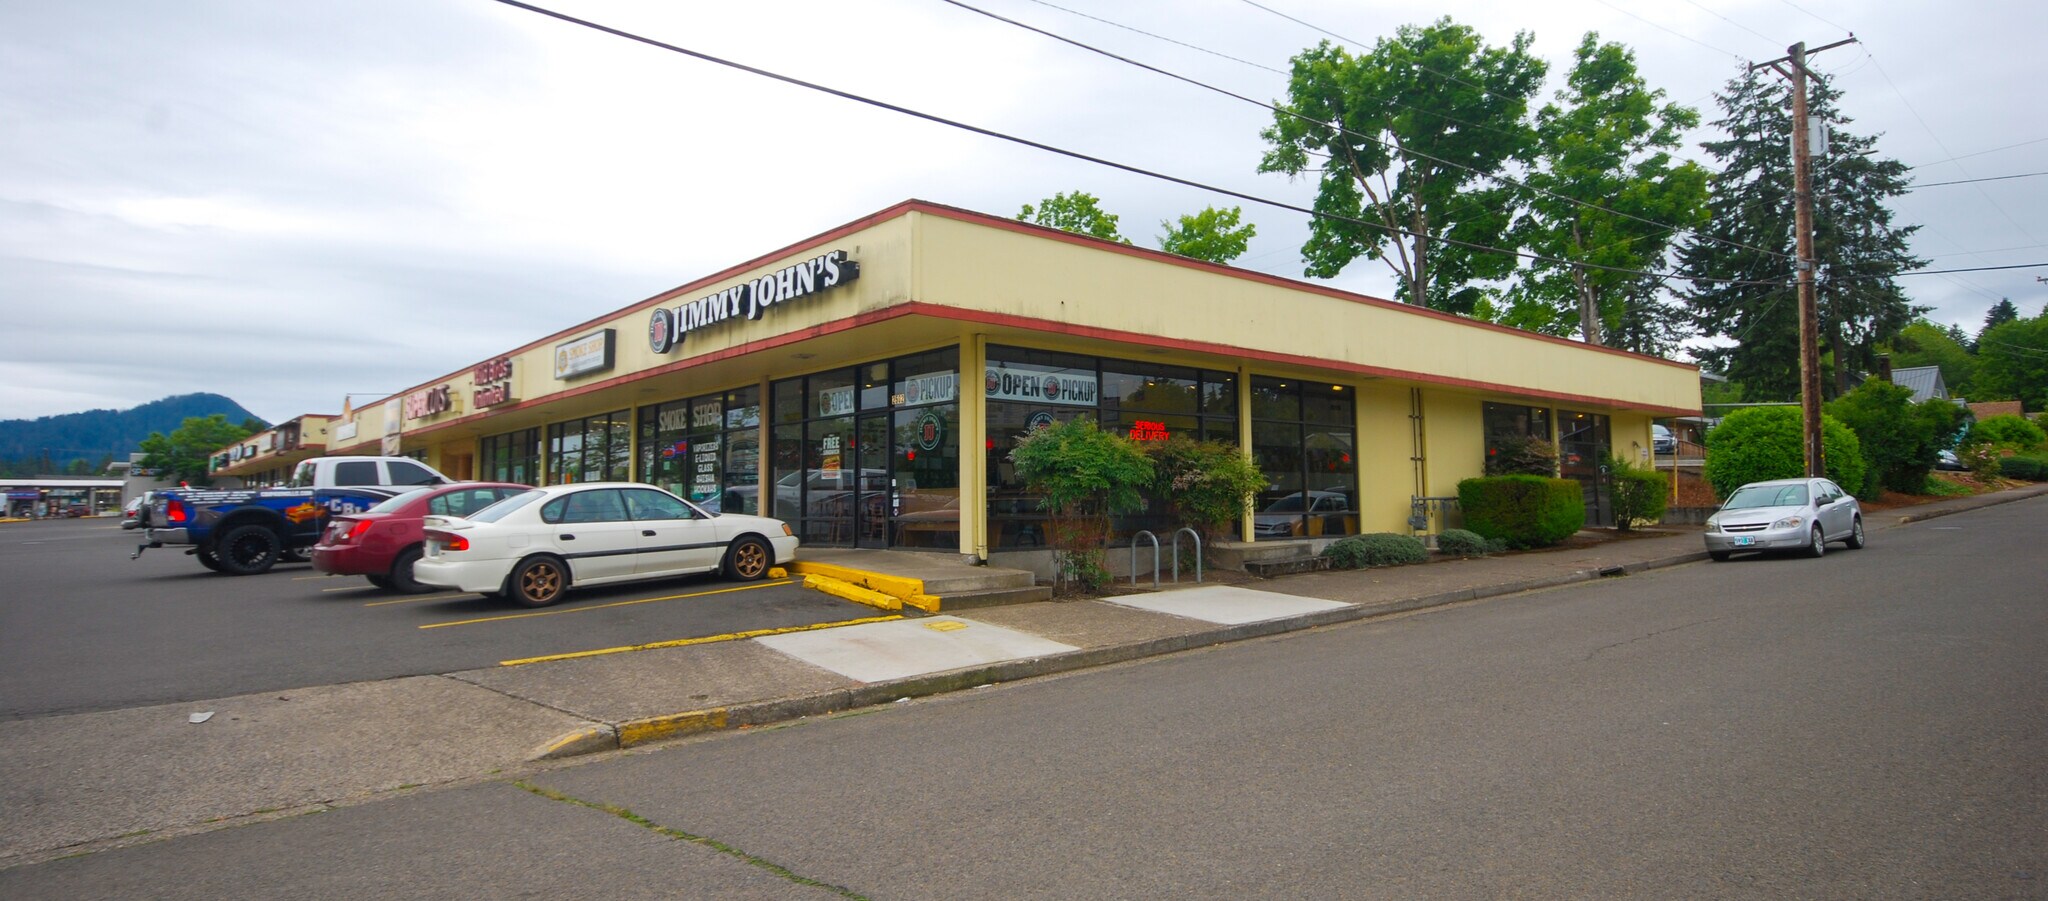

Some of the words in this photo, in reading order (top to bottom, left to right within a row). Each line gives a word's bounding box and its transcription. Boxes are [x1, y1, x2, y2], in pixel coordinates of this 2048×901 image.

[672, 284, 744, 344] JIMMY
[748, 250, 840, 320] JOHN'S
[921, 376, 952, 400] PICKUP
[1002, 373, 1040, 397] OPEN
[1062, 379, 1096, 402] PICKUP
[831, 389, 854, 411] OPEN
[659, 408, 687, 432] SMOKE
[693, 402, 722, 427] SHOP
[1135, 420, 1165, 431] SERIOUS
[822, 436, 840, 450] FREE
[1130, 429, 1170, 441] DELIVERY
[697, 463, 713, 473] GLASS
